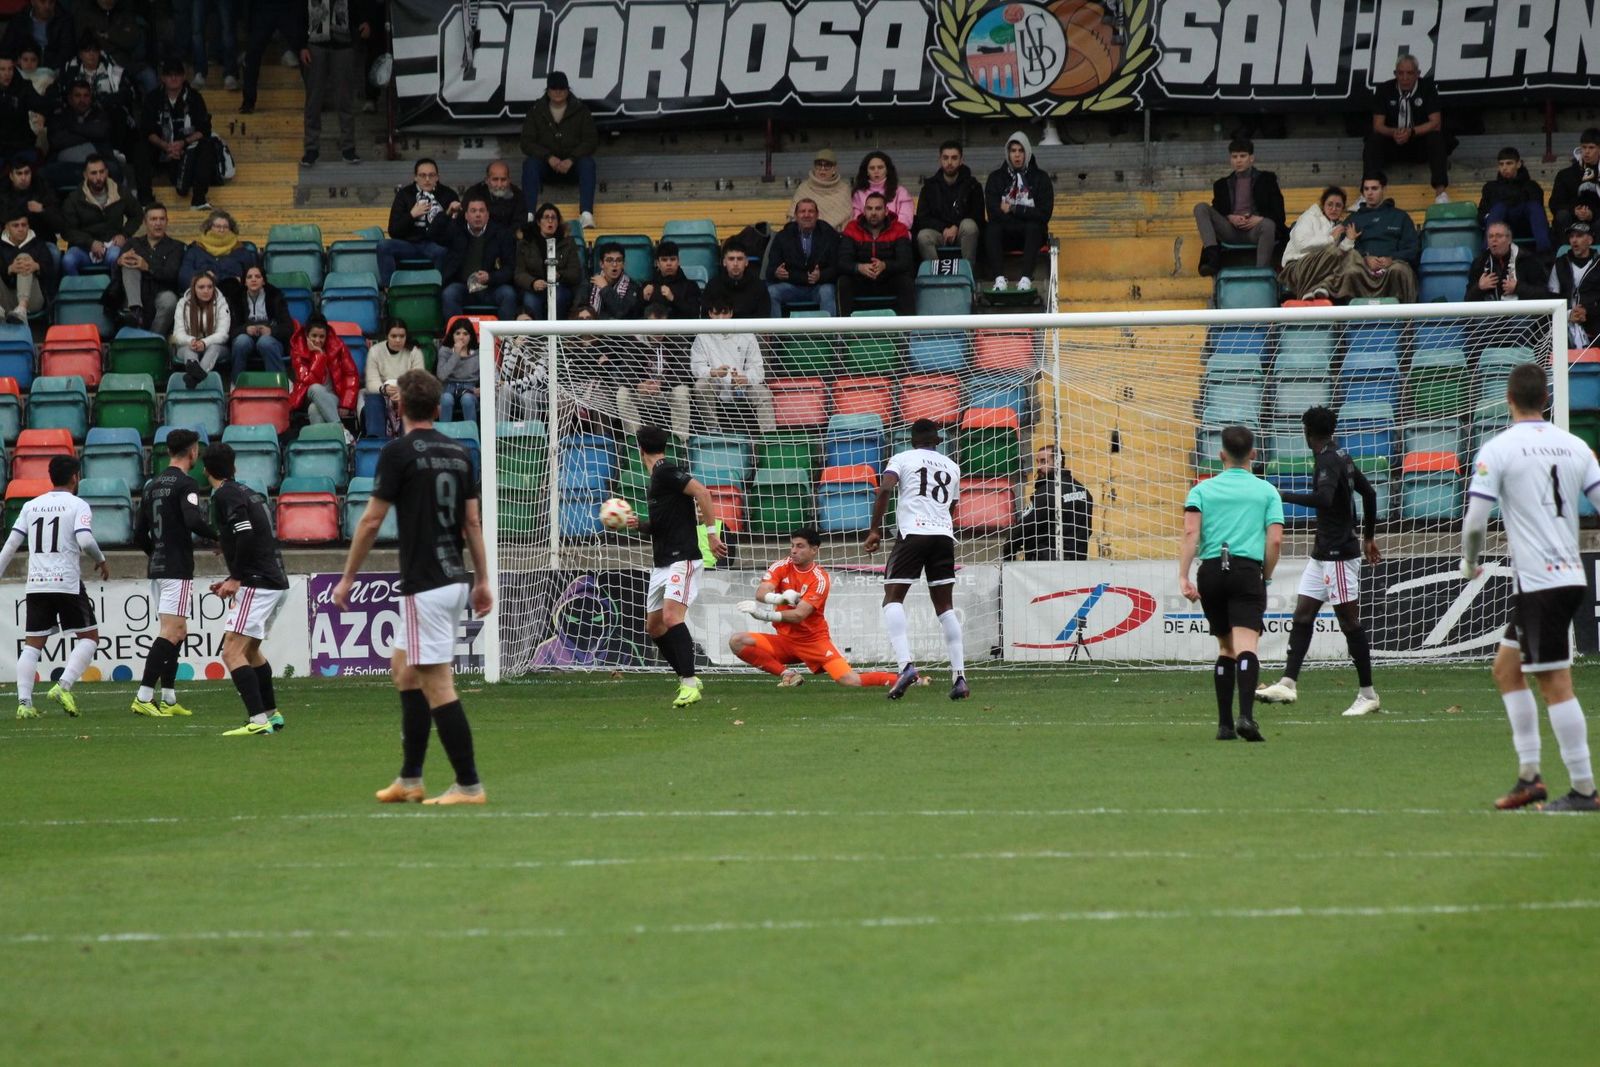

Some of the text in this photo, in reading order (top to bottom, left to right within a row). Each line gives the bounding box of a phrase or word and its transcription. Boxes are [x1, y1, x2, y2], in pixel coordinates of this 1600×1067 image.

[442, 0, 932, 102] GLORIOSA
[1164, 0, 1355, 86] SAN
[436, 472, 457, 528] 9
[915, 466, 952, 504] 18
[31, 516, 61, 554] 11
[312, 609, 485, 660] AZQE
[1164, 620, 1184, 634] DE
